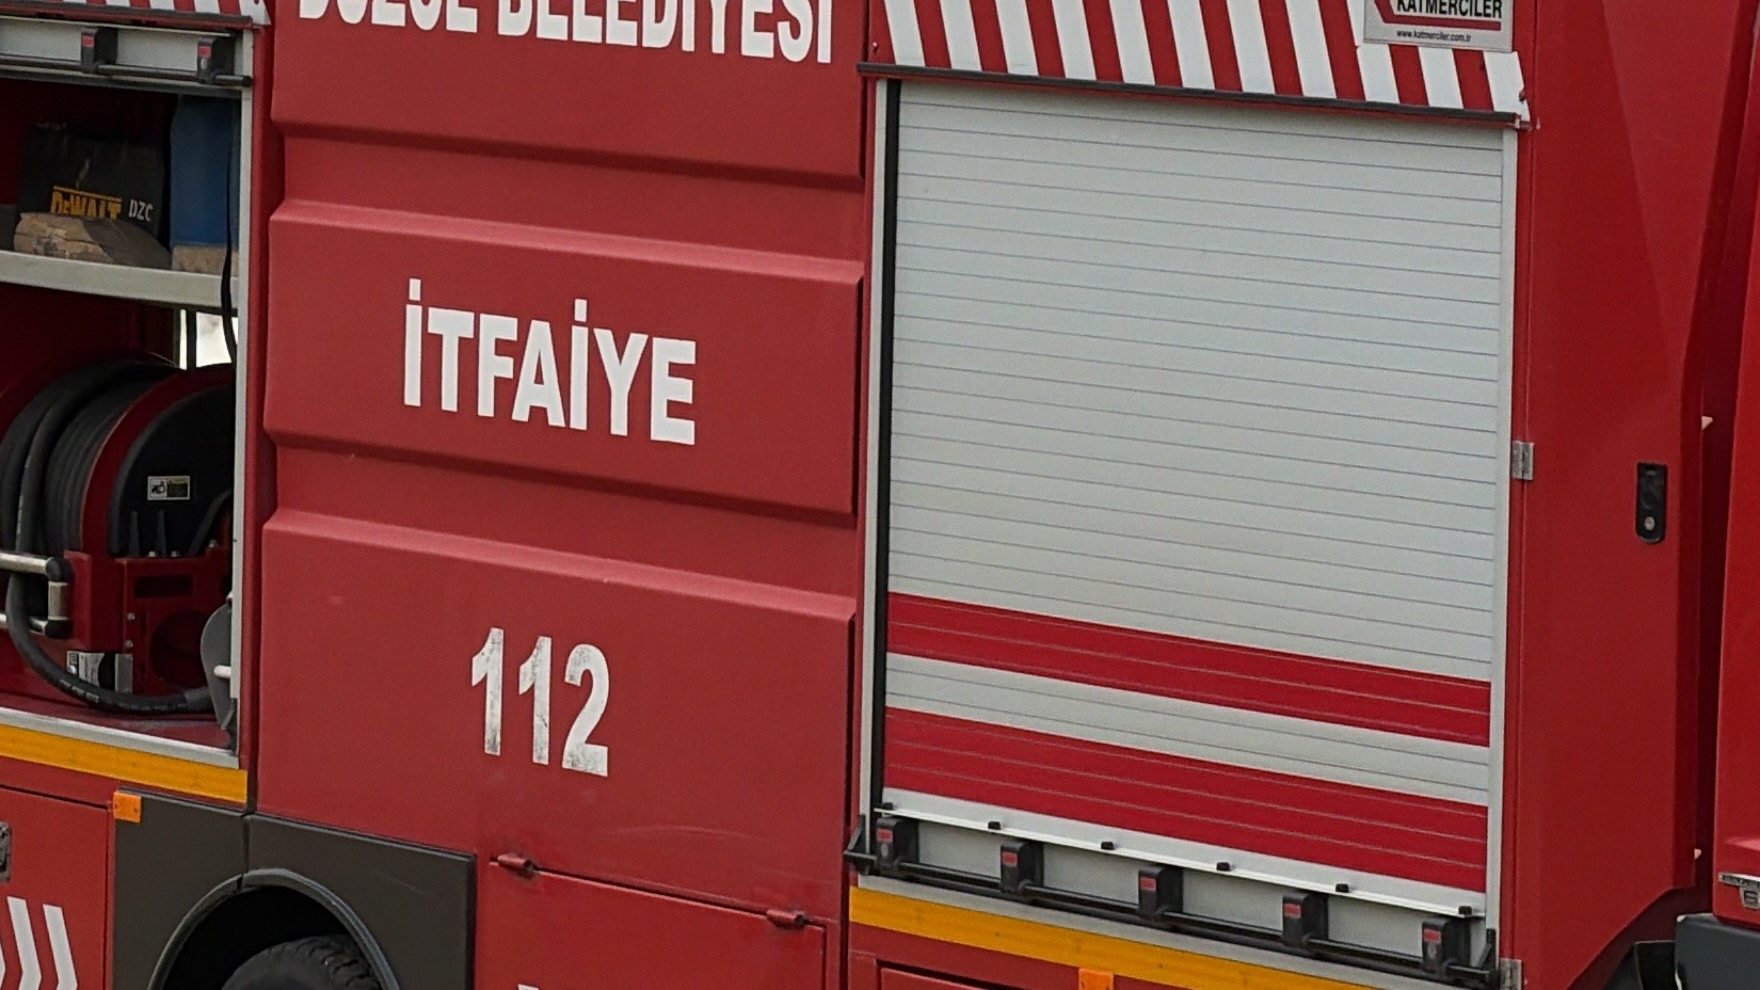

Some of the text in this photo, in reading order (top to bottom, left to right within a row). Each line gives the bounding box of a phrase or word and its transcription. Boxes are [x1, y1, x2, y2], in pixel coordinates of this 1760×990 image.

[1396, 29, 1472, 43] www.katmerciler.com.tr
[128, 198, 154, 222] DZC
[403, 278, 697, 446] İTFAİYE
[471, 627, 610, 778] 112
